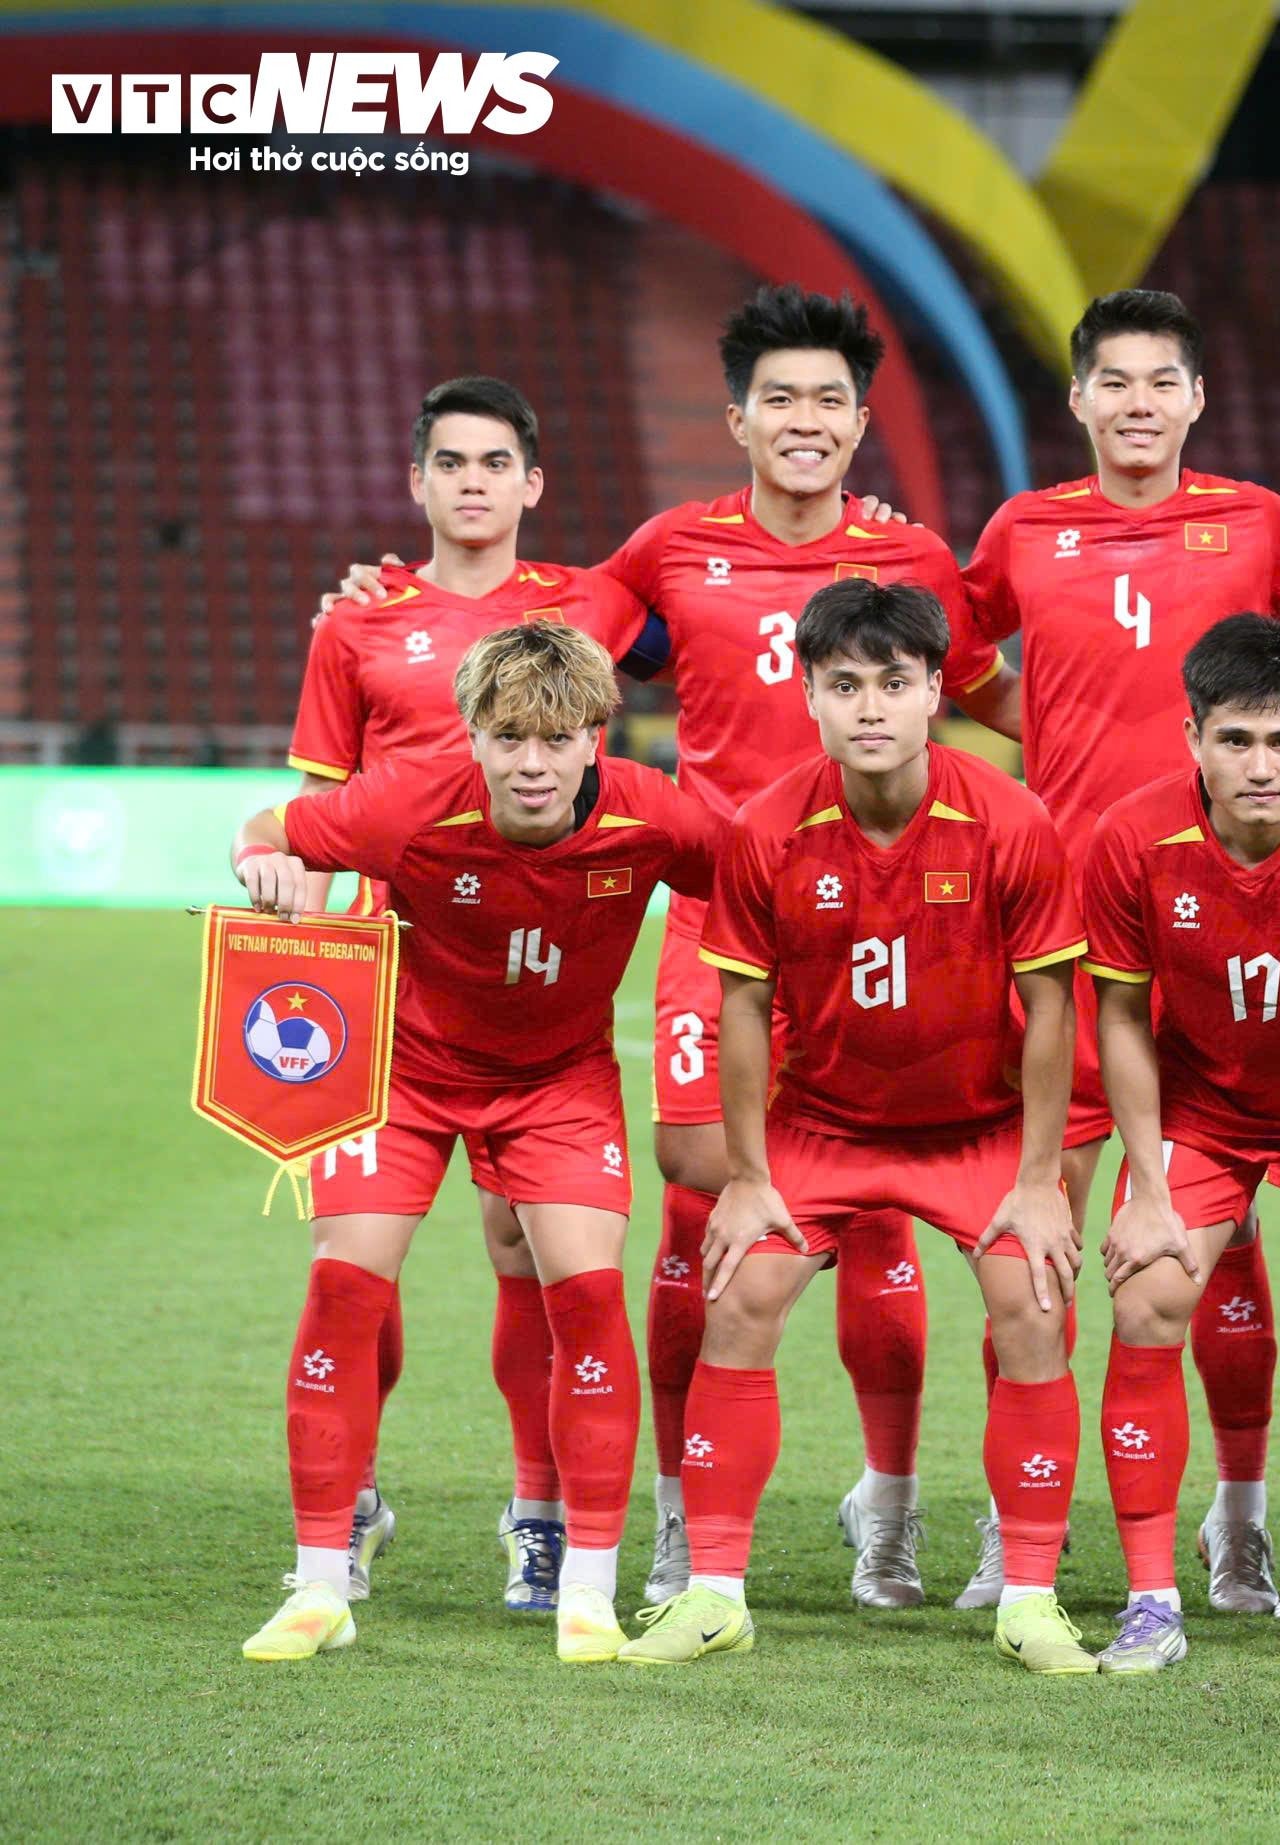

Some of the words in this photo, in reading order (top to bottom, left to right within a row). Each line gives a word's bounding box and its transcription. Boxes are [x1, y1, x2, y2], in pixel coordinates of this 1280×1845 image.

[756, 611, 798, 686] 3
[1114, 573, 1151, 649] 4
[228, 933, 267, 952] VIETNAM
[270, 937, 316, 957] FOOTBALL
[319, 941, 376, 963] FEDERATION
[505, 927, 562, 985] 14
[851, 934, 907, 1010] 21
[279, 1055, 310, 1071] VFF
[670, 1011, 705, 1086] 3
